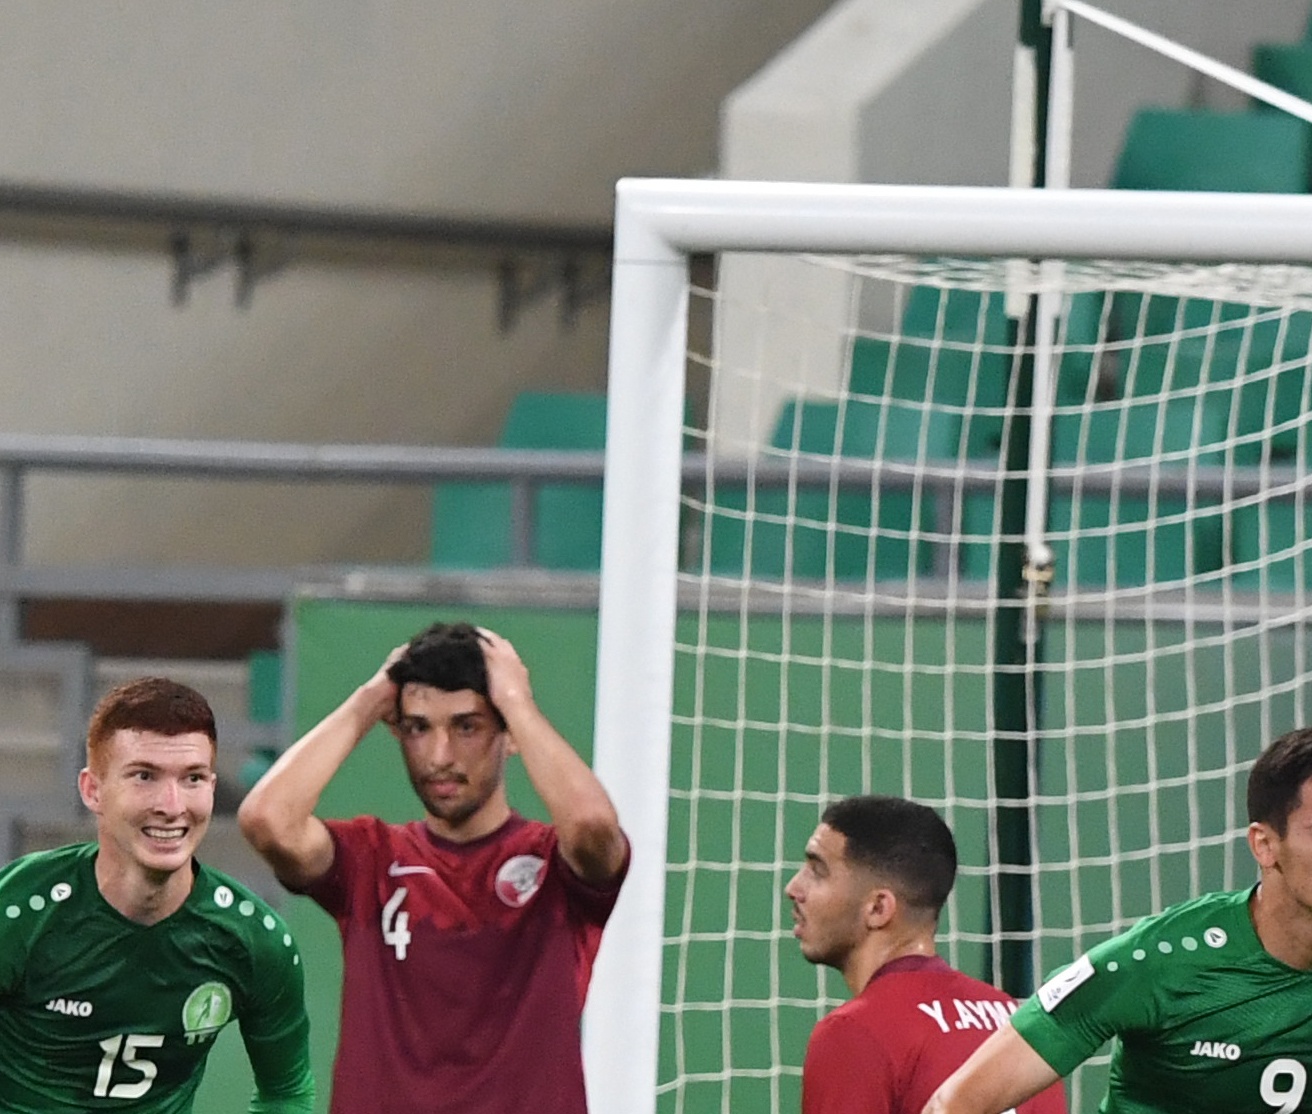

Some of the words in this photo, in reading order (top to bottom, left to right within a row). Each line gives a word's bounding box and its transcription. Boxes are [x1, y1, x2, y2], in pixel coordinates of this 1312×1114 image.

[381, 886, 411, 961] 4
[45, 998, 93, 1018] JAKO
[93, 1033, 166, 1099] 15
[1189, 1040, 1242, 1061] JAKO
